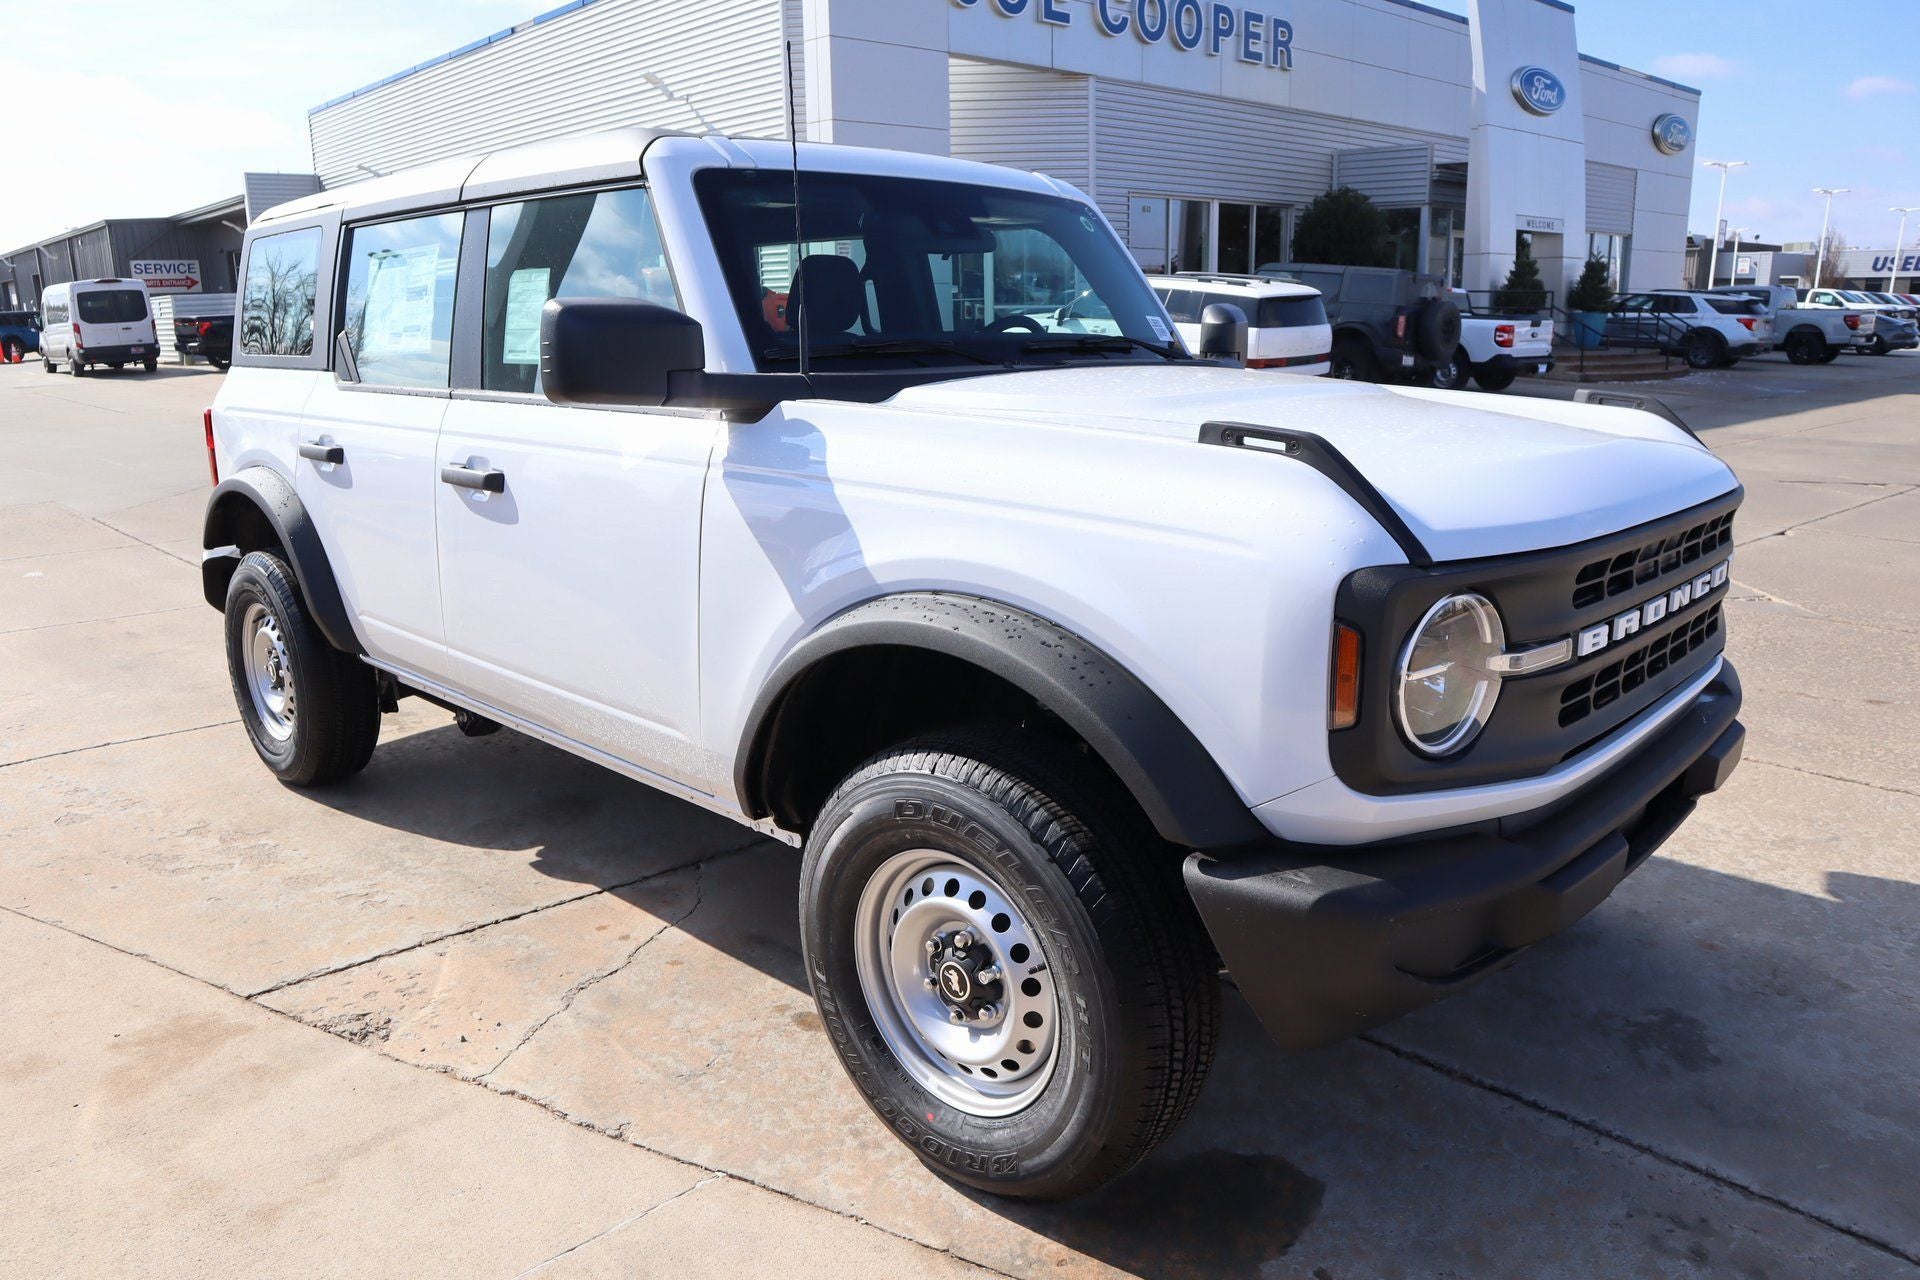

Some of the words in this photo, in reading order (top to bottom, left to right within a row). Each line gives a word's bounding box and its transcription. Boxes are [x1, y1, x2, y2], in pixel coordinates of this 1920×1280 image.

[1094, 0, 1294, 71] COOPER
[1531, 75, 1558, 104] Ford
[1667, 122, 1688, 146] Ford
[1526, 219, 1555, 230] WELCOME
[133, 262, 196, 275] SERVICE
[1577, 560, 1729, 657] BRONCO
[892, 798, 1080, 975] DUELER
[810, 952, 1019, 1175] BRIDGESTONE
